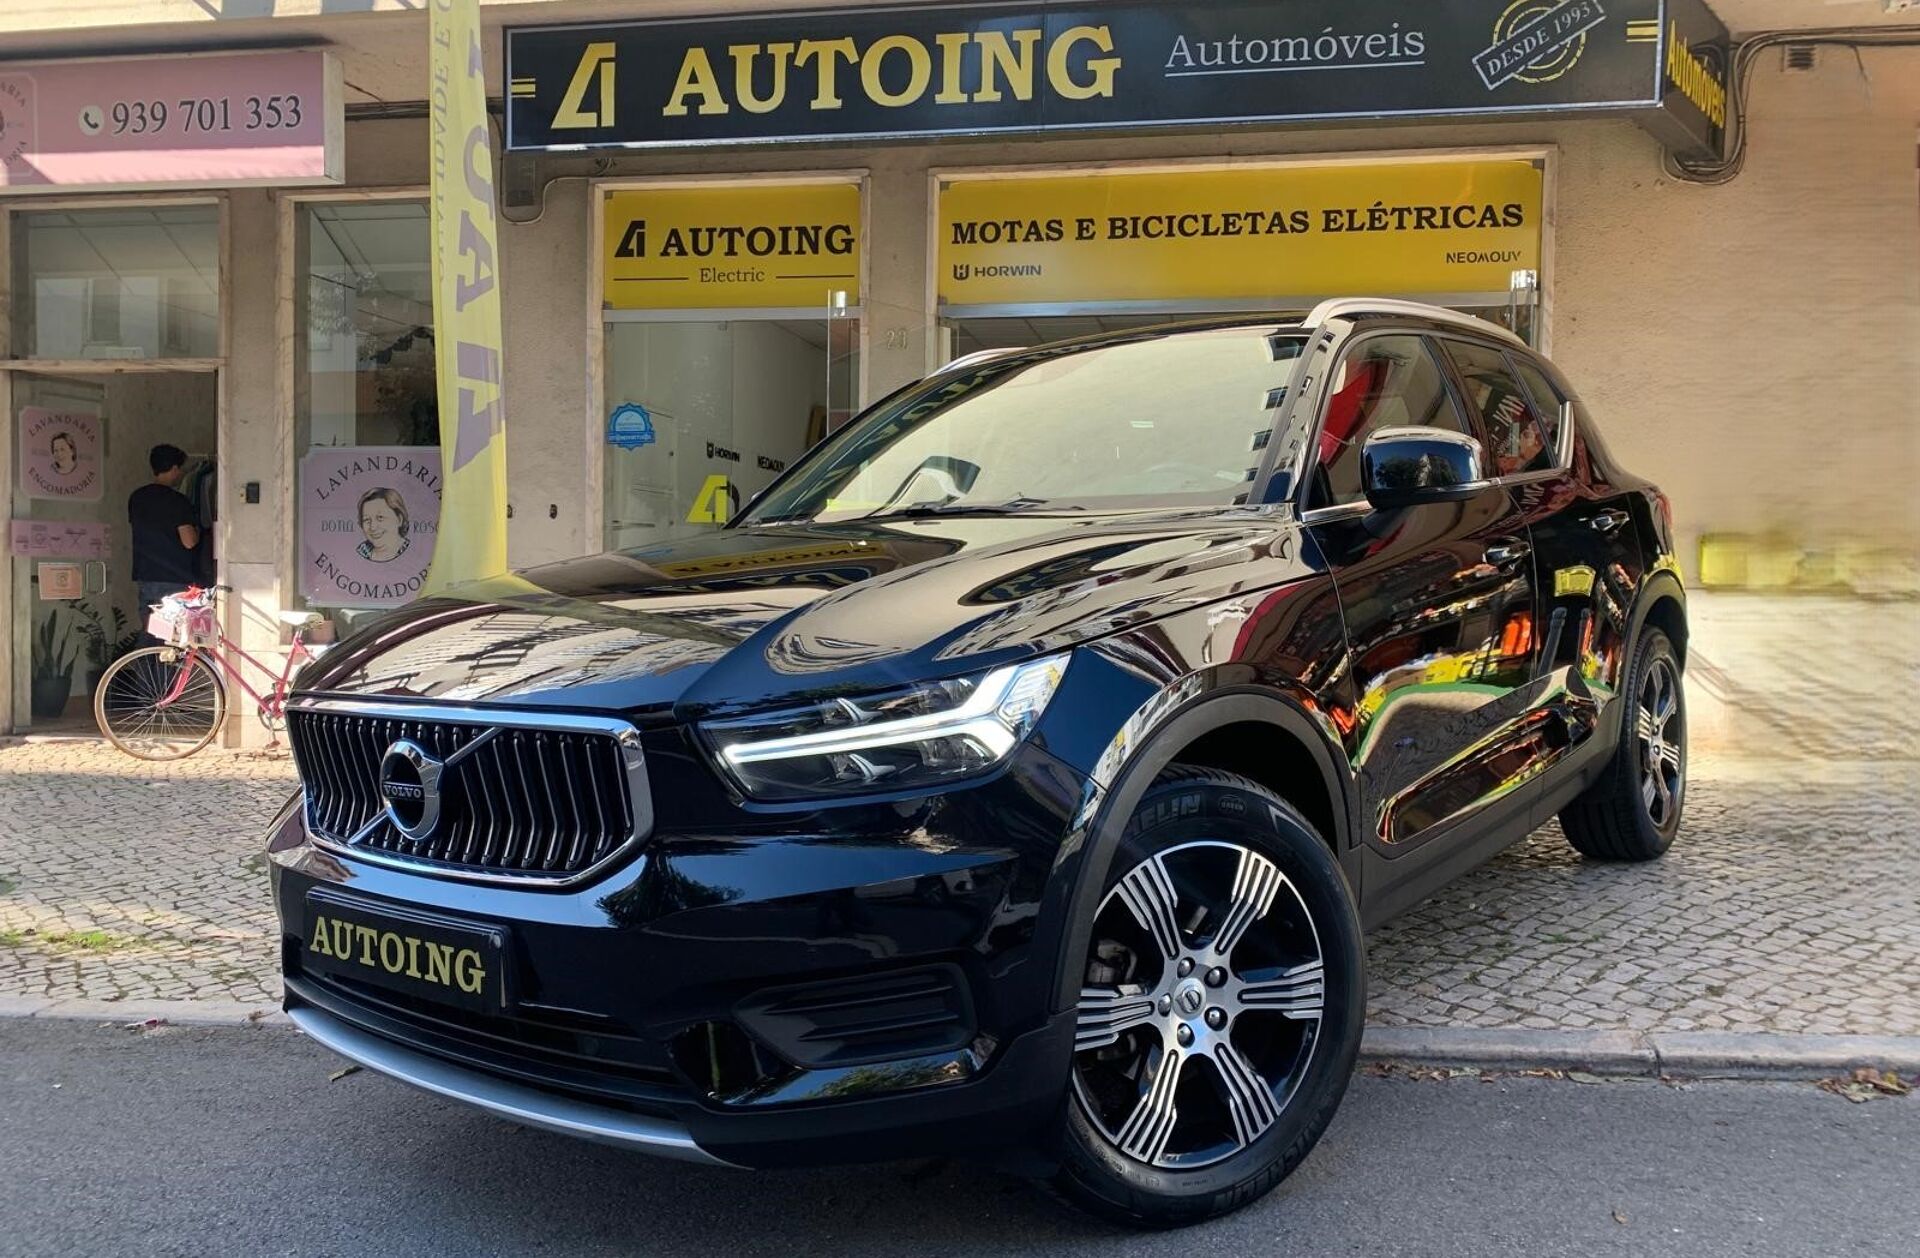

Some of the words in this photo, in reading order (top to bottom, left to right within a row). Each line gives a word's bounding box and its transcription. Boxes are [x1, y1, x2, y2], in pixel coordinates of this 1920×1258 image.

[1164, 22, 1426, 67] Automóveis
[1487, 27, 1551, 76] DESDE
[1553, 1, 1591, 34] 1993
[662, 24, 1122, 116] AUTOING
[112, 102, 167, 135] 939
[178, 98, 231, 132] 701
[246, 95, 301, 129] 353
[660, 225, 855, 257] AUTOING
[951, 219, 1064, 244] MOTAS
[1075, 218, 1096, 240] E
[1107, 210, 1310, 240] BICICLETAS
[1321, 201, 1524, 233] ELÉTRICAS
[699, 268, 765, 283] Electric
[974, 264, 1042, 278] HORWIN
[1446, 250, 1522, 264] NEOMOUV
[314, 552, 432, 599] ENGOMADOR
[384, 785, 421, 798] VOLVO
[309, 915, 486, 995] AUTOING
